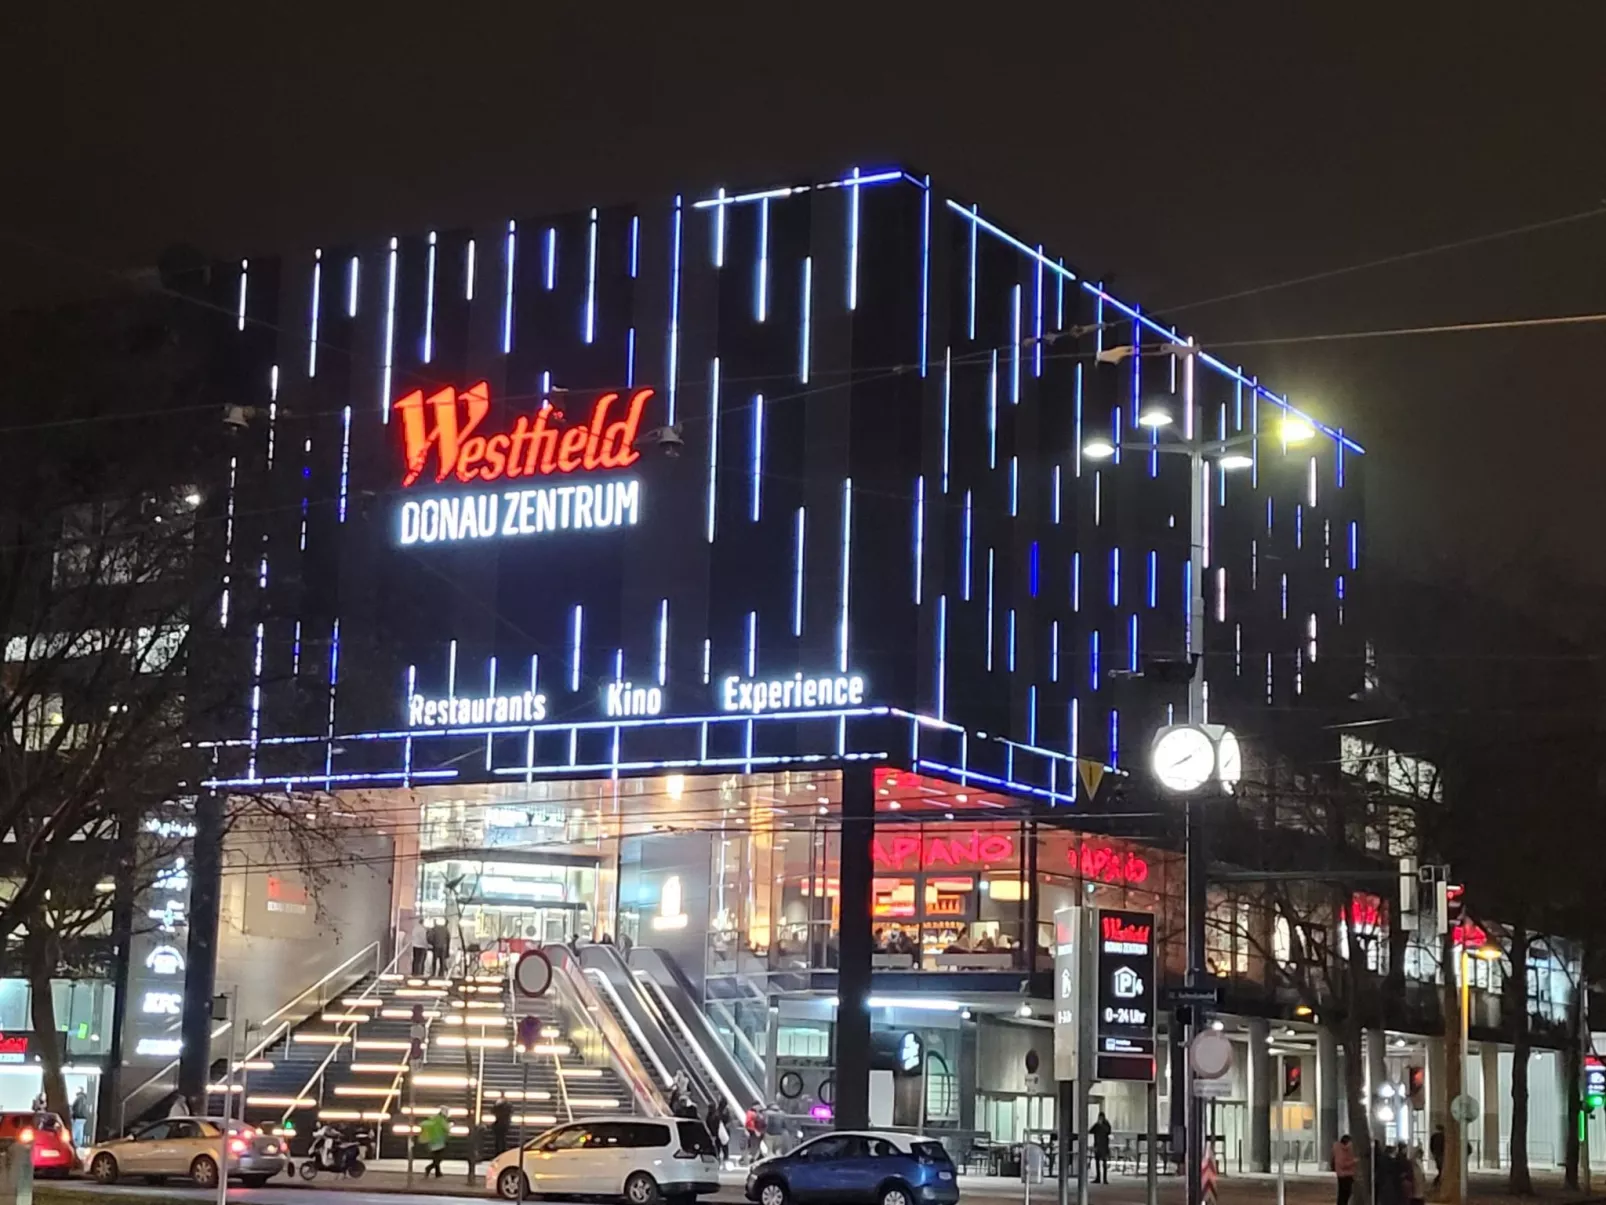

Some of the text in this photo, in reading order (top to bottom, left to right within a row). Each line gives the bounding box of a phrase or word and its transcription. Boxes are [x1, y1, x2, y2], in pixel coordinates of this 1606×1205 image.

[394, 380, 654, 487] Westfield
[401, 480, 639, 544] DONAU ZENTRUM
[408, 672, 864, 727] Restaurants Kino Experience
[1119, 973, 1133, 993] P
[1105, 1007, 1147, 1024] 0-24 Uhr
